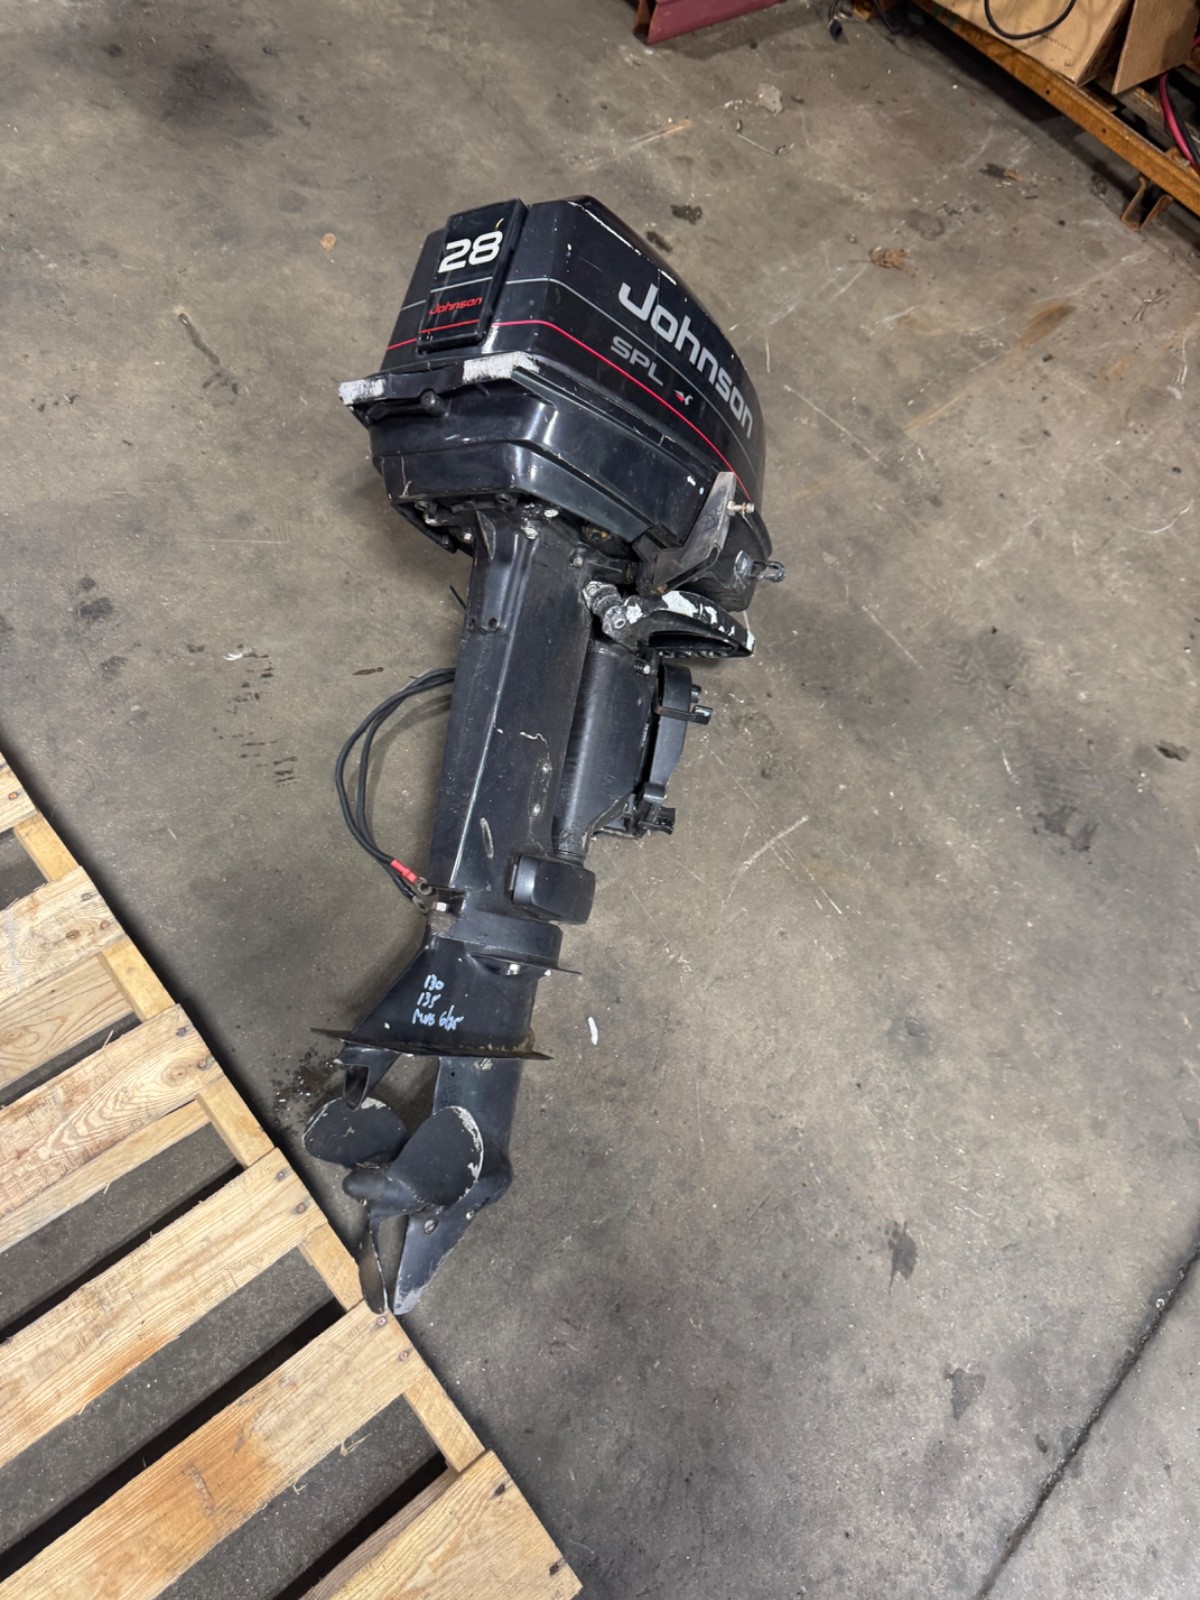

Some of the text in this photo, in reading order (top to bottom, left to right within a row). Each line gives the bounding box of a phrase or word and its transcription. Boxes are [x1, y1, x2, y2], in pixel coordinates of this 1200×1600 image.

[438, 231, 503, 273] 28
[429, 297, 483, 315] Johnson
[610, 335, 664, 387] SPL
[618, 282, 753, 439] Johnson
[424, 974, 445, 991] 130
